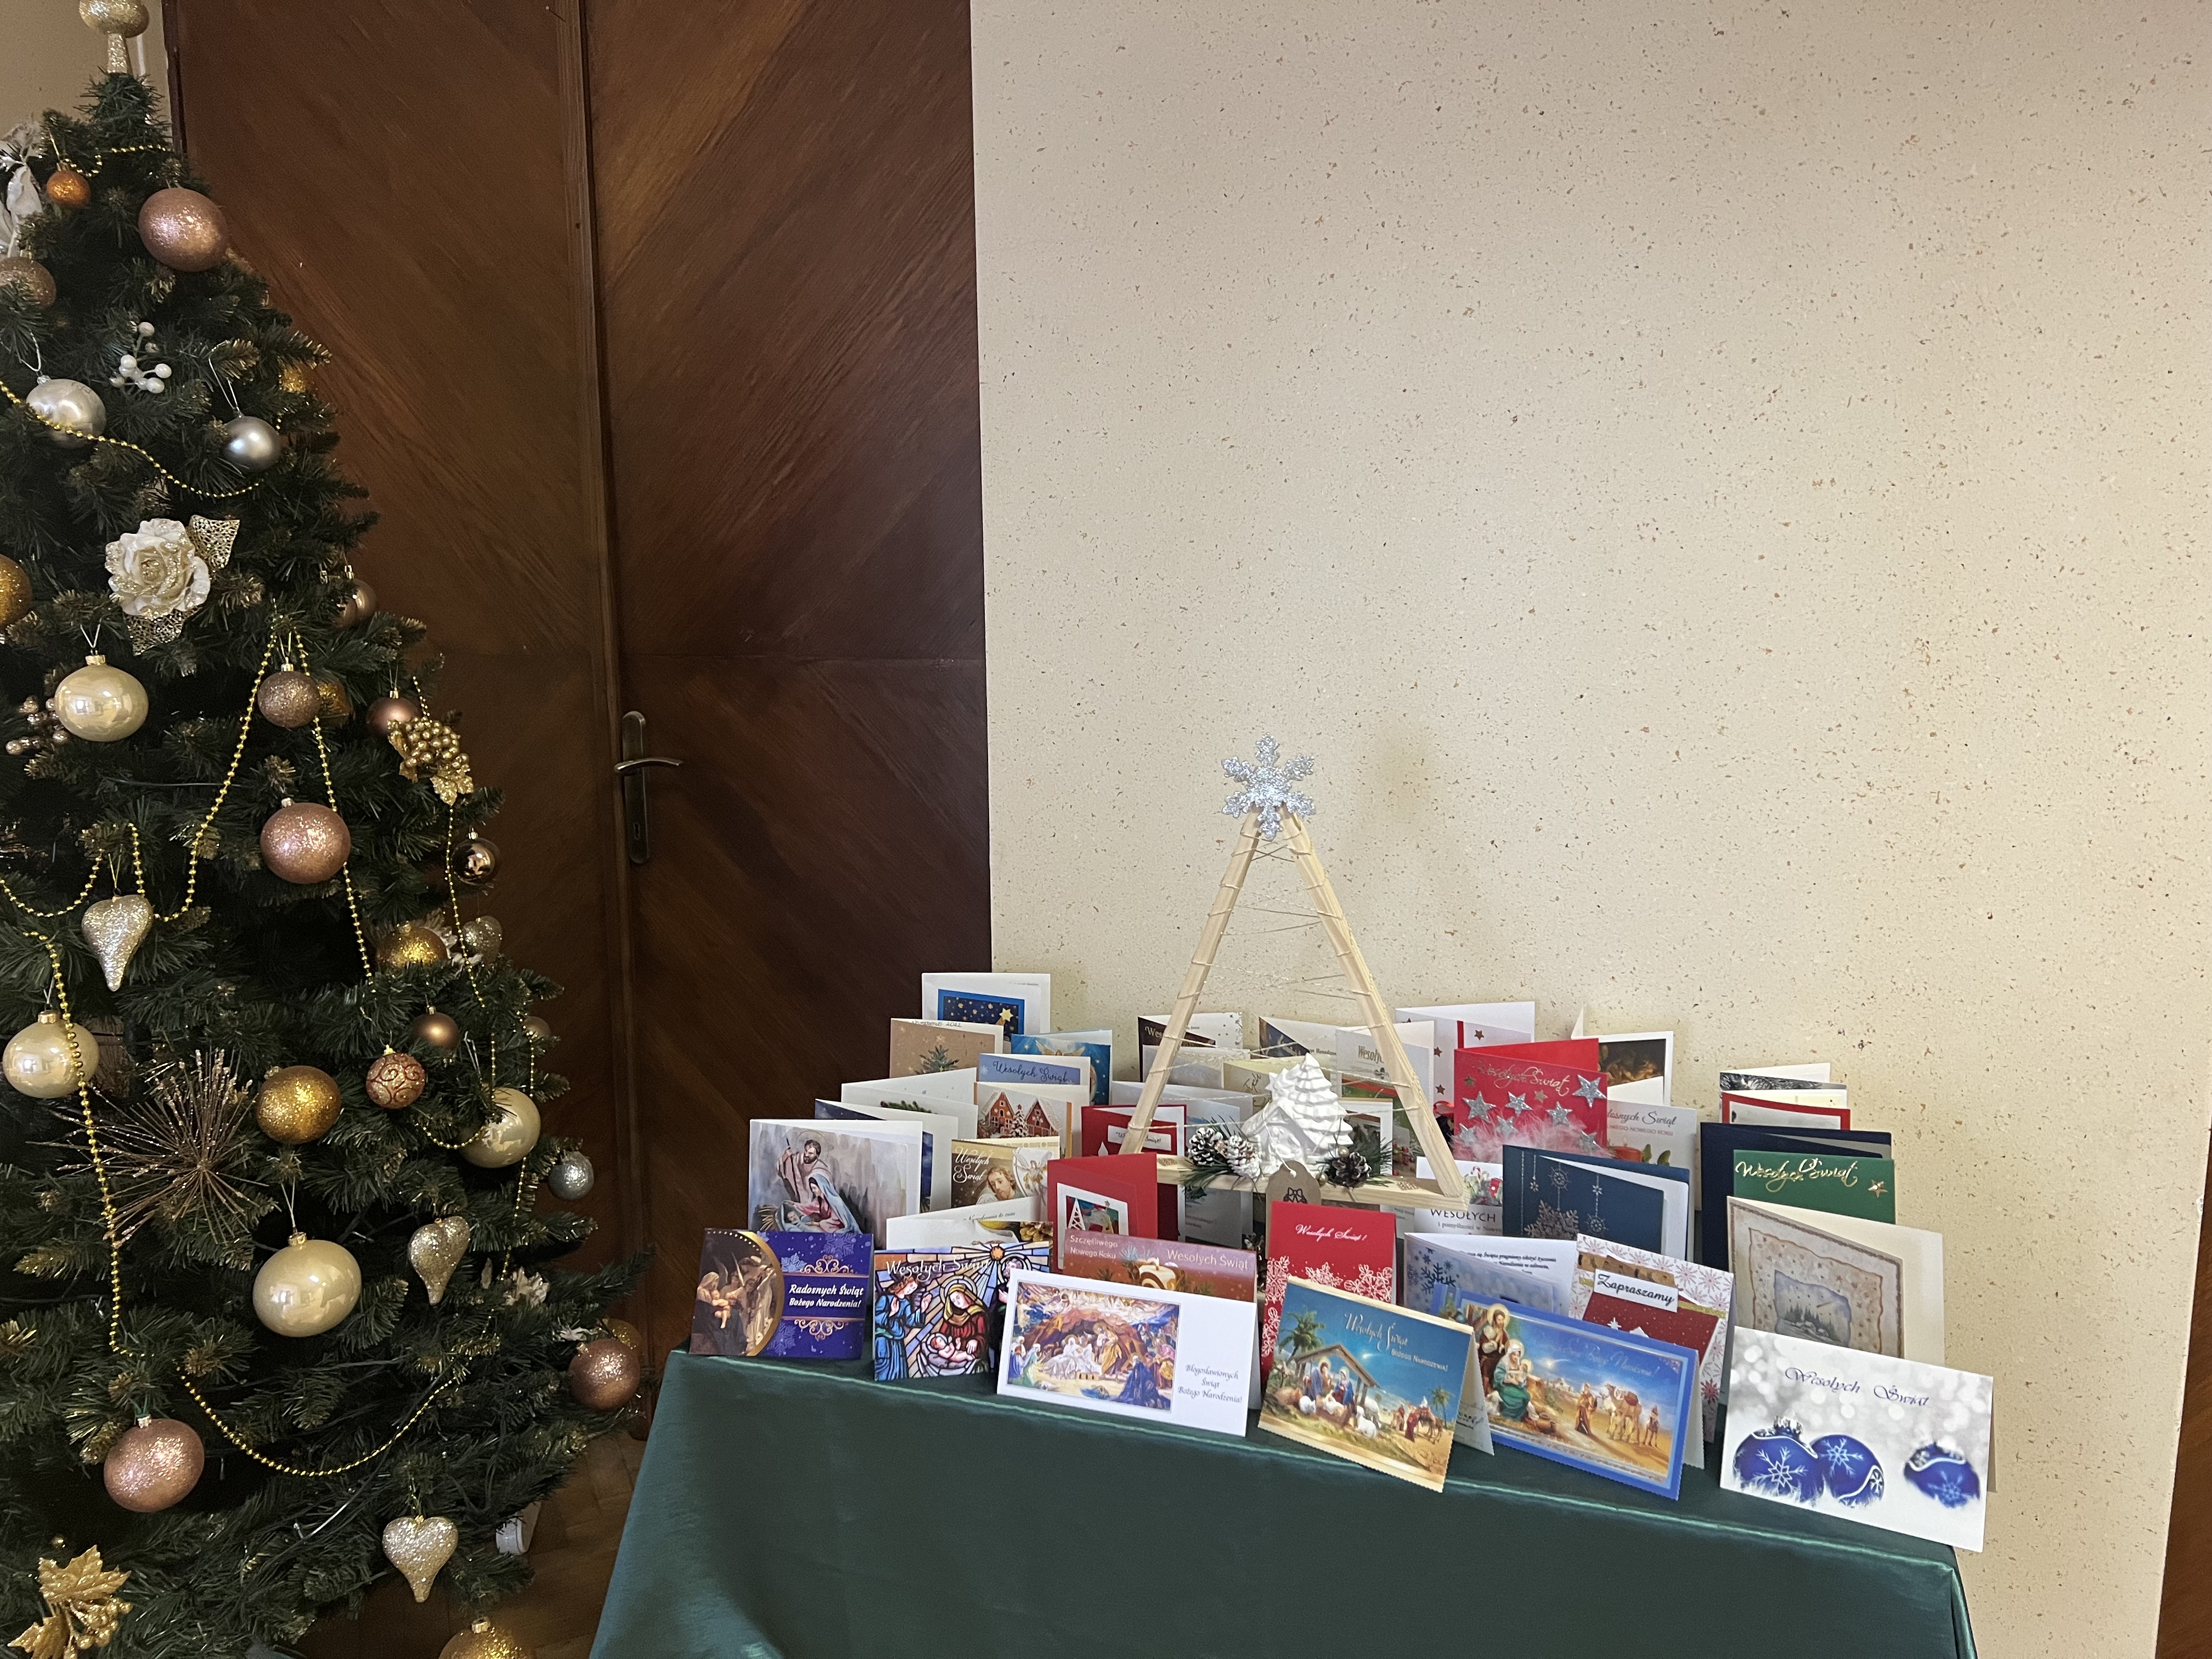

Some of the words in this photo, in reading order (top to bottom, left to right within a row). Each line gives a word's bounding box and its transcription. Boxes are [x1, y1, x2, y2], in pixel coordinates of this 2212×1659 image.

[1642, 1110, 1677, 1127] Świąt
[1430, 1209, 1496, 1222] WESOŁYCH
[1070, 1234, 1118, 1249] Szczęśliwego
[1070, 1247, 1098, 1257] Nowego
[1099, 1250, 1116, 1260] Roku
[1220, 1254, 1248, 1271] Świąt
[789, 1284, 837, 1297] Radosnych
[839, 1283, 864, 1298] Świąt
[1597, 1273, 1675, 1307] Zapraszamy
[789, 1297, 814, 1308] Bożego
[816, 1299, 862, 1308] Narodzenia!
[1201, 1377, 1220, 1389] Świąt
[1178, 1386, 1200, 1399] Bożego
[1202, 1389, 1243, 1403] Narodzenia!
[1874, 1385, 1929, 1406] Świąt
